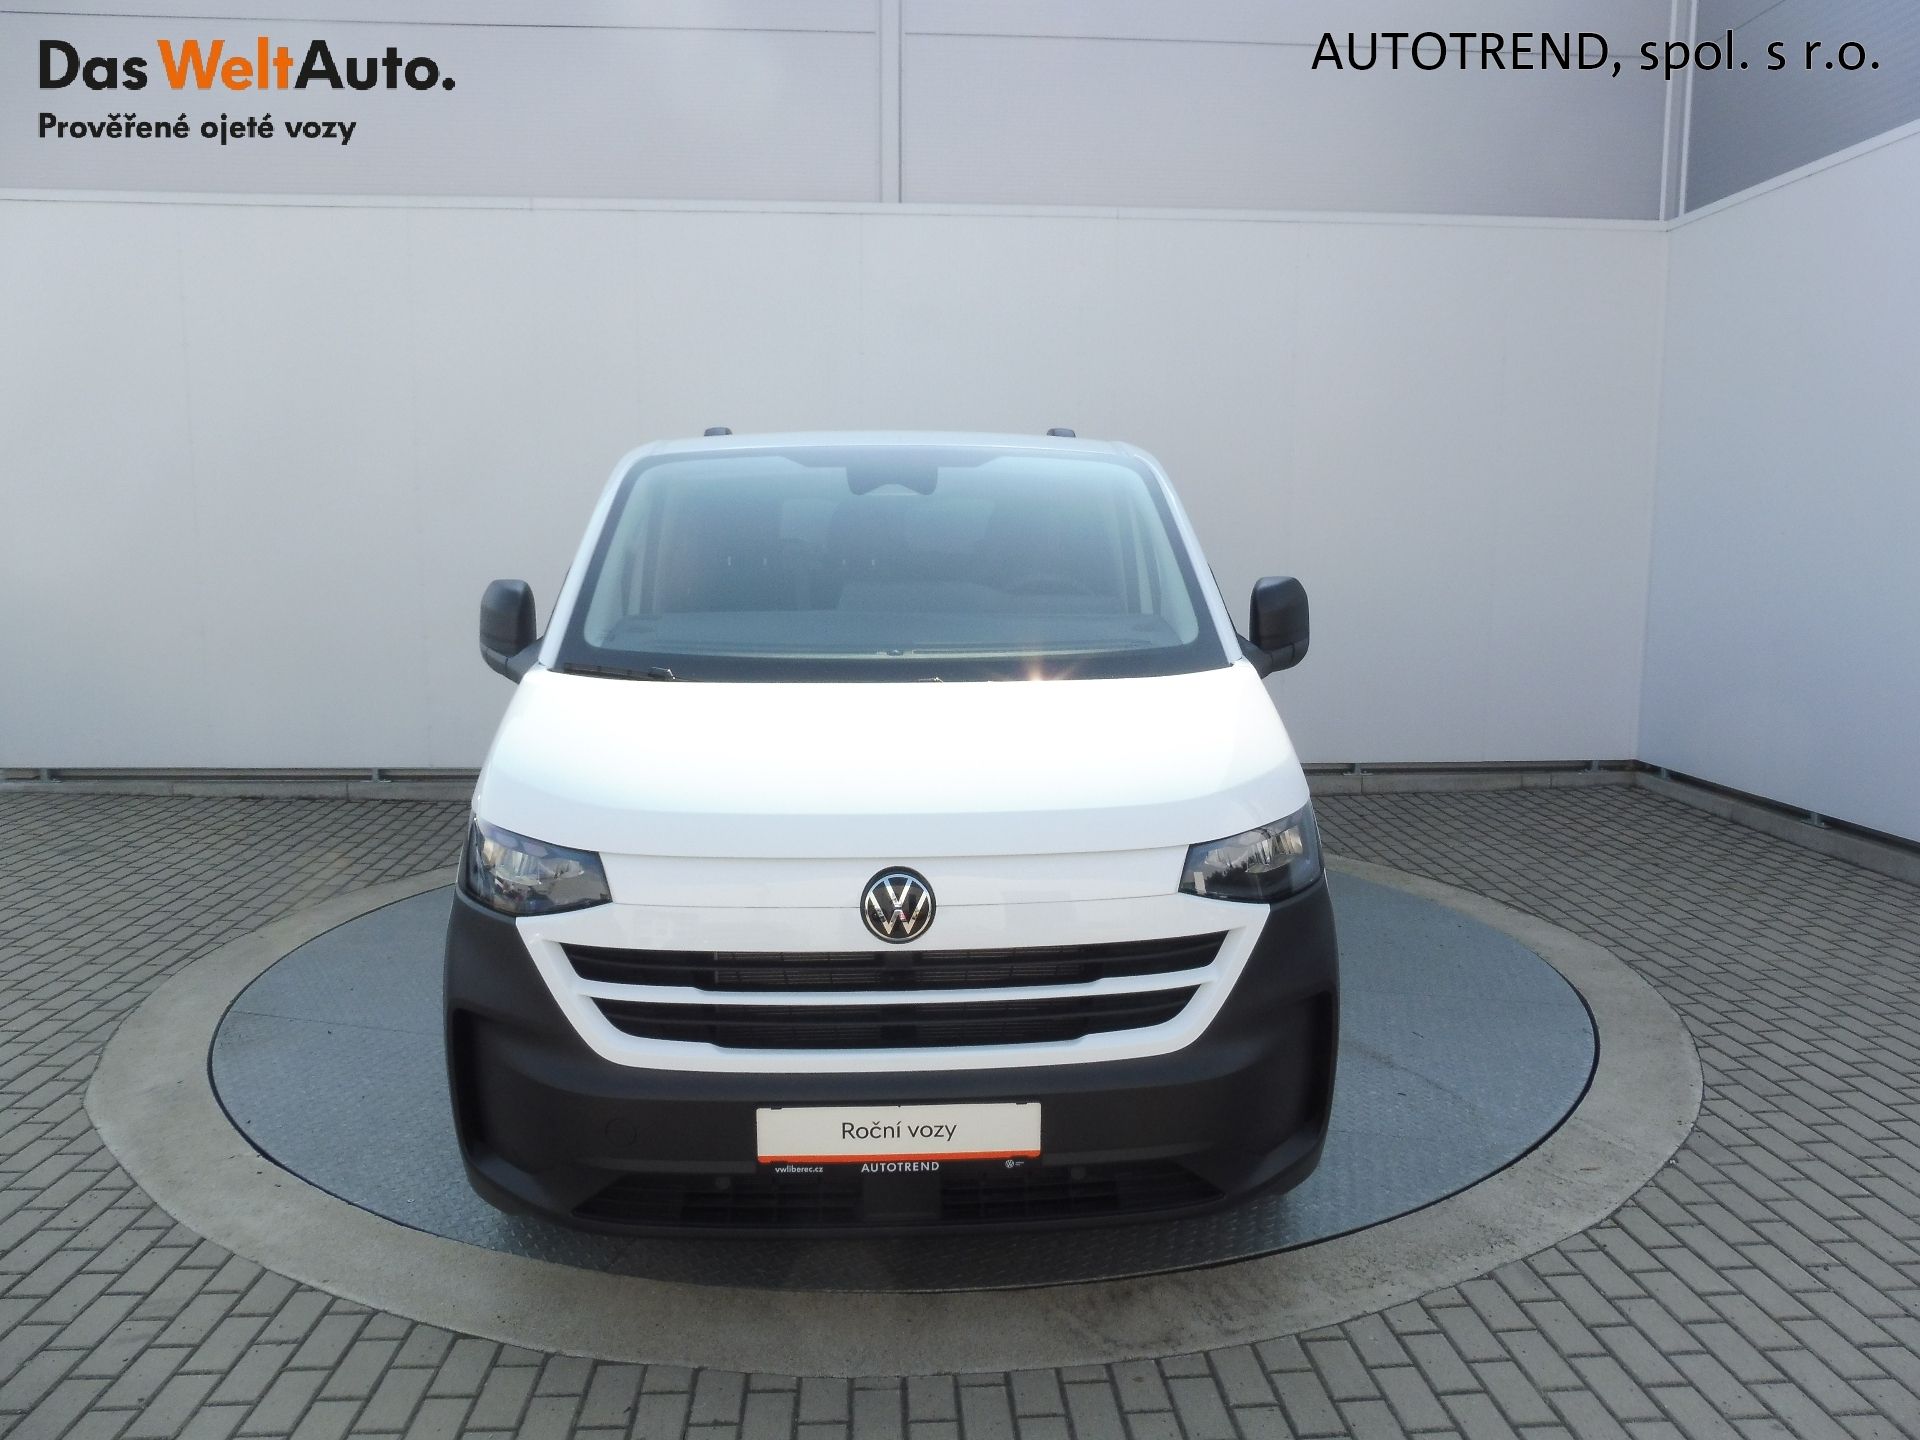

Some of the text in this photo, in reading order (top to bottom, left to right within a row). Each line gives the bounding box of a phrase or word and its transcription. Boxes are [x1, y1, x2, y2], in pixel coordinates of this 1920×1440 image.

[842, 1121, 957, 1142] Roční vozy
[775, 1165, 824, 1174] vwliberec.cz
[861, 1161, 940, 1174] AUTOTREND
